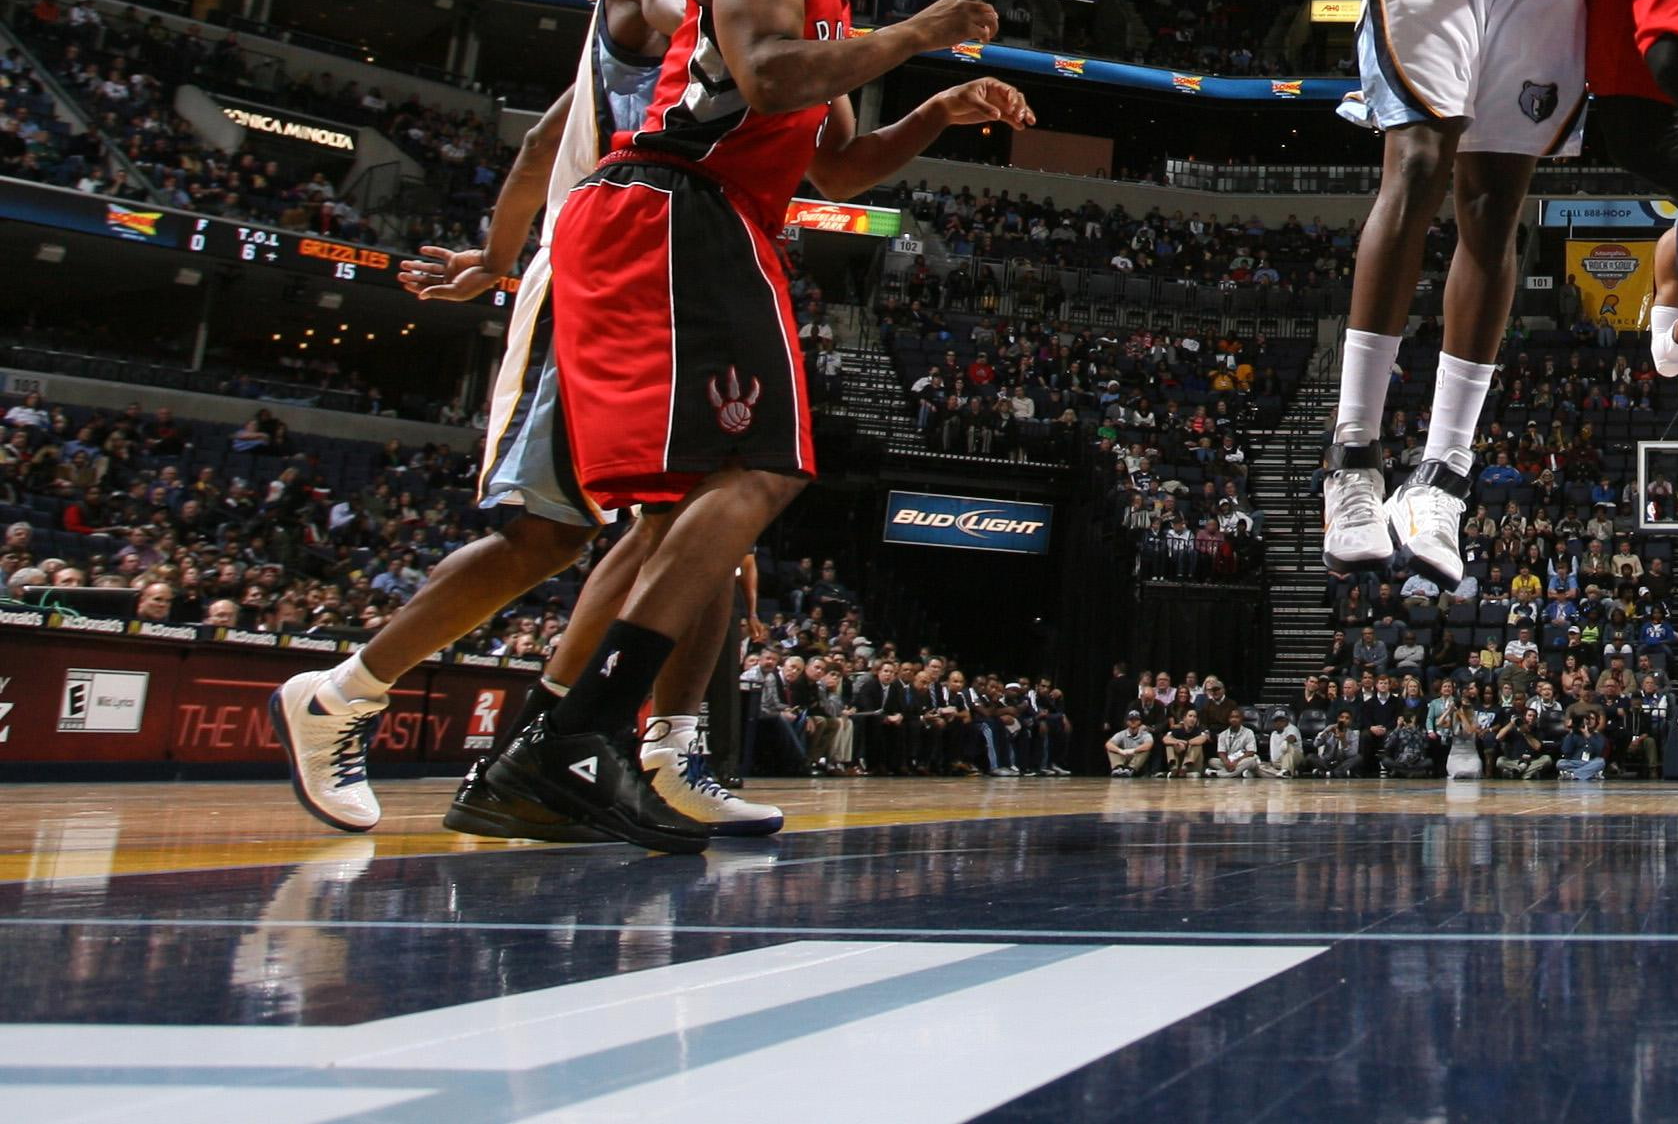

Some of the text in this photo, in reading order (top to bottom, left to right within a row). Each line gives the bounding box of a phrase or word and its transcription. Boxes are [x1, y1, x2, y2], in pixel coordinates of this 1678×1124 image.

[284, 122, 354, 150] MINOLTA
[790, 210, 851, 224] SOUTHLAND
[1560, 209, 1632, 217] CALL 888-HOOP
[816, 222, 846, 231] PARK
[299, 239, 391, 269] GRIZZLIES
[900, 241, 918, 252] 102
[242, 244, 253, 260] 6
[335, 262, 355, 280] 15
[1533, 278, 1548, 287] 101
[495, 291, 505, 306] 8
[893, 509, 1044, 535] BUD LIGHT
[62, 616, 124, 633] McDonald's
[142, 623, 197, 640] McDonald's
[227, 630, 278, 646] McDonald's
[70, 684, 84, 716] E
[474, 692, 498, 733] 2K
[178, 704, 242, 748] THE
[369, 712, 450, 751] ASTY
